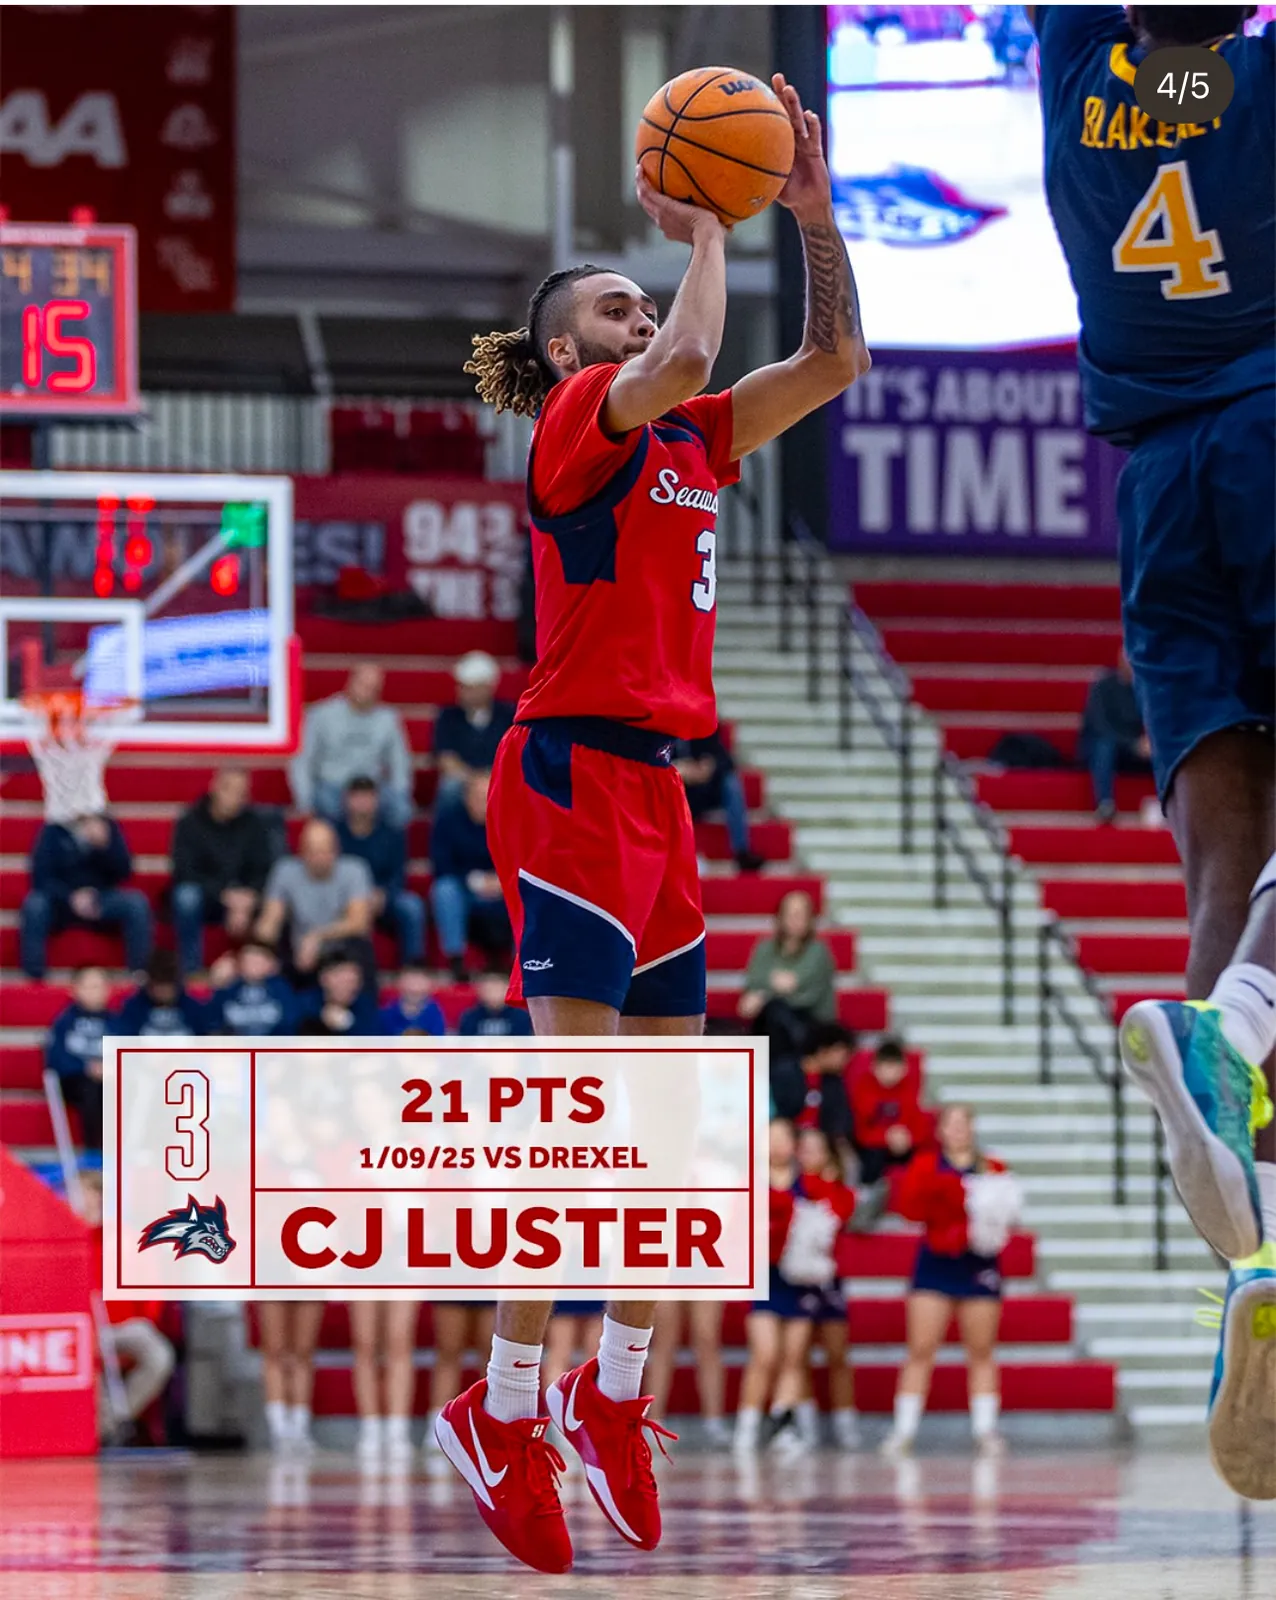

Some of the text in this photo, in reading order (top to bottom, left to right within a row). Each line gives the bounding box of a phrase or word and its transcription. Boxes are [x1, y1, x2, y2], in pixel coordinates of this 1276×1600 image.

[1080, 95, 1222, 151] BLAKE
[1112, 159, 1232, 300] 4
[22, 300, 97, 393] 15
[932, 366, 1079, 424] ABOUT
[842, 426, 1088, 536] TIME
[692, 529, 717, 613] 3
